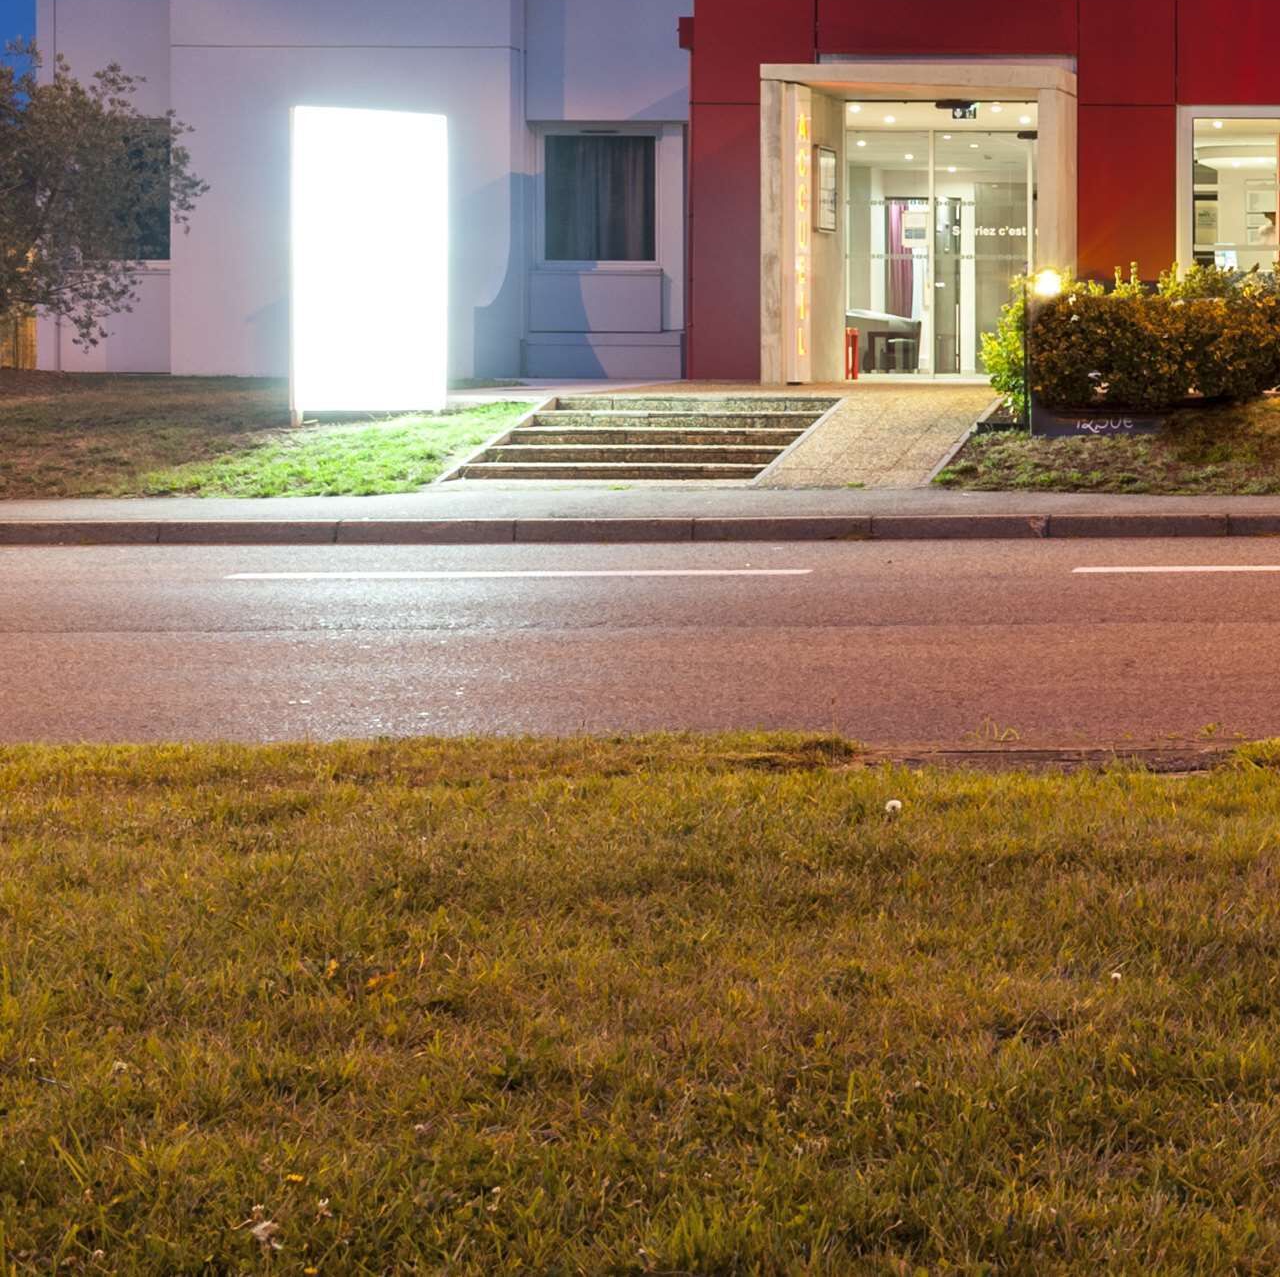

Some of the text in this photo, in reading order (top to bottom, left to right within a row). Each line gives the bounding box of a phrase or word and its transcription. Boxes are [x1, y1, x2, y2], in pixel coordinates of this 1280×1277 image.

[796, 113, 810, 356] ACCUEIL
[951, 225, 997, 237] Sriez
[998, 225, 1027, 237] c'est
